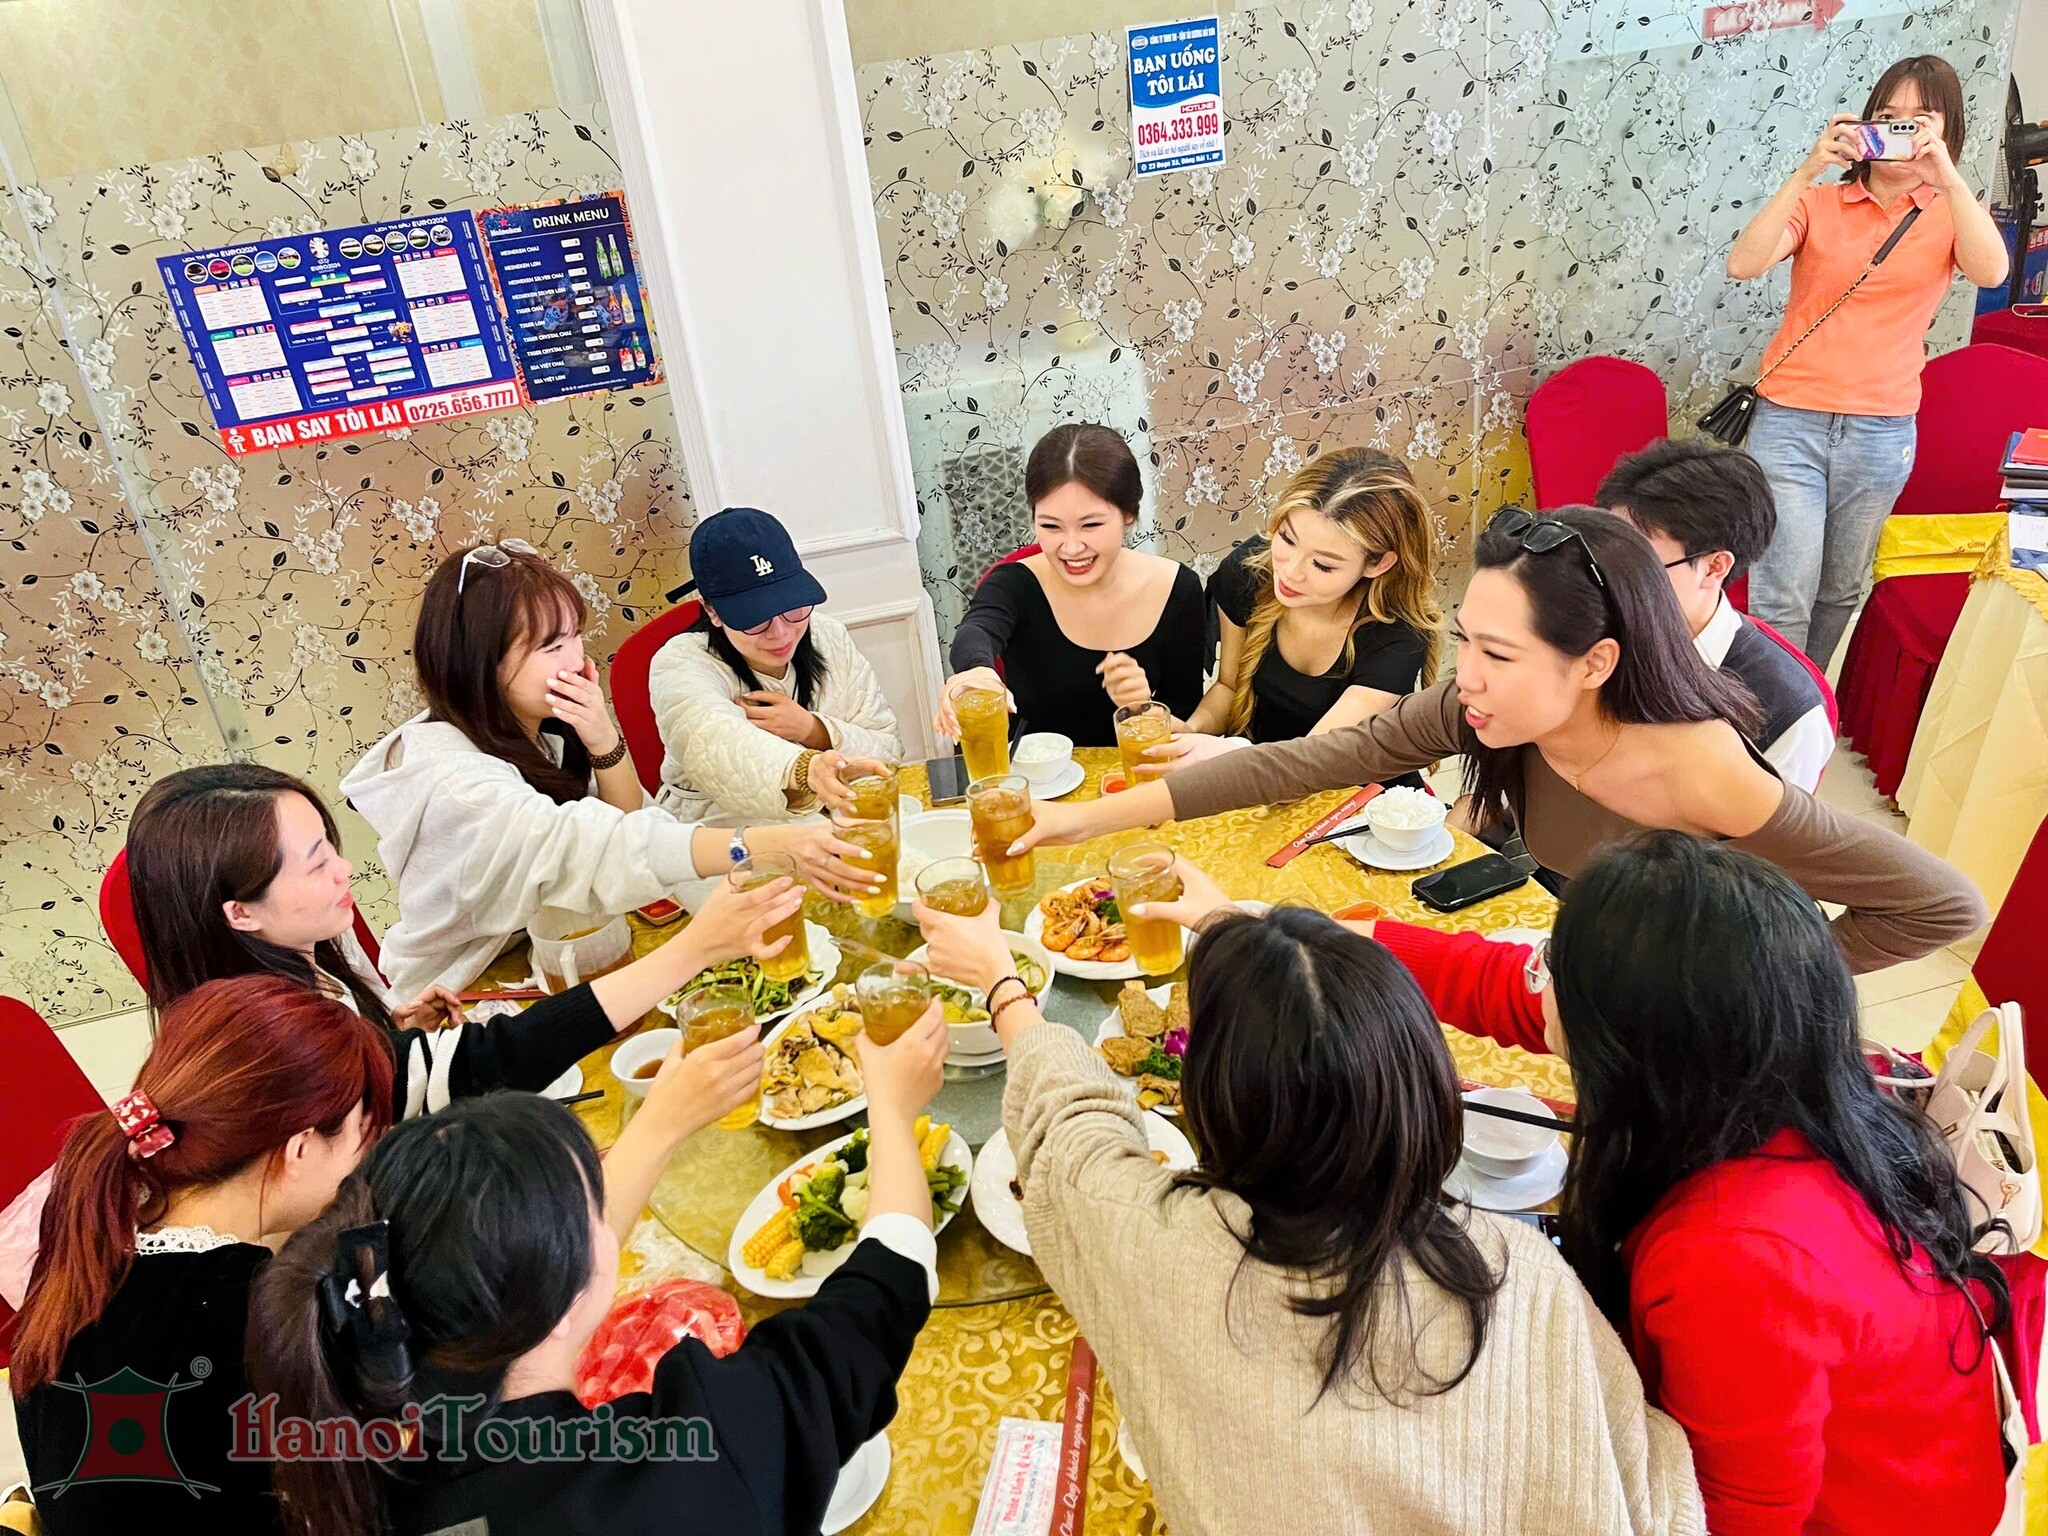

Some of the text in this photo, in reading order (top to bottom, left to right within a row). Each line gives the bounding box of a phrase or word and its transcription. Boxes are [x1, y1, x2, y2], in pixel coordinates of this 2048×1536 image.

[1133, 43, 1216, 77] BẠN UỐNG
[1147, 70, 1205, 96] TÔI LÁI
[1182, 102, 1214, 113] HOTLINE
[1138, 113, 1218, 146] 0364.333.999
[412, 216, 448, 228] EURO2024
[532, 208, 610, 230] DRINK MENU
[490, 226, 522, 237] Heineken
[220, 246, 258, 257] EURO2024
[500, 248, 527, 256] HEINEKEN
[310, 262, 341, 272] EURO2024
[504, 263, 530, 271] HEINEKEN
[508, 276, 534, 286] HEINEKEN
[512, 291, 538, 300] HEINEKEN
[408, 390, 514, 421] 0225.656.7777
[251, 401, 402, 449] BẠN SAY TÔI LÁI
[750, 554, 774, 576] LA
[1066, 1448, 1080, 1482] khách
[1073, 1422, 1086, 1450] ngon
